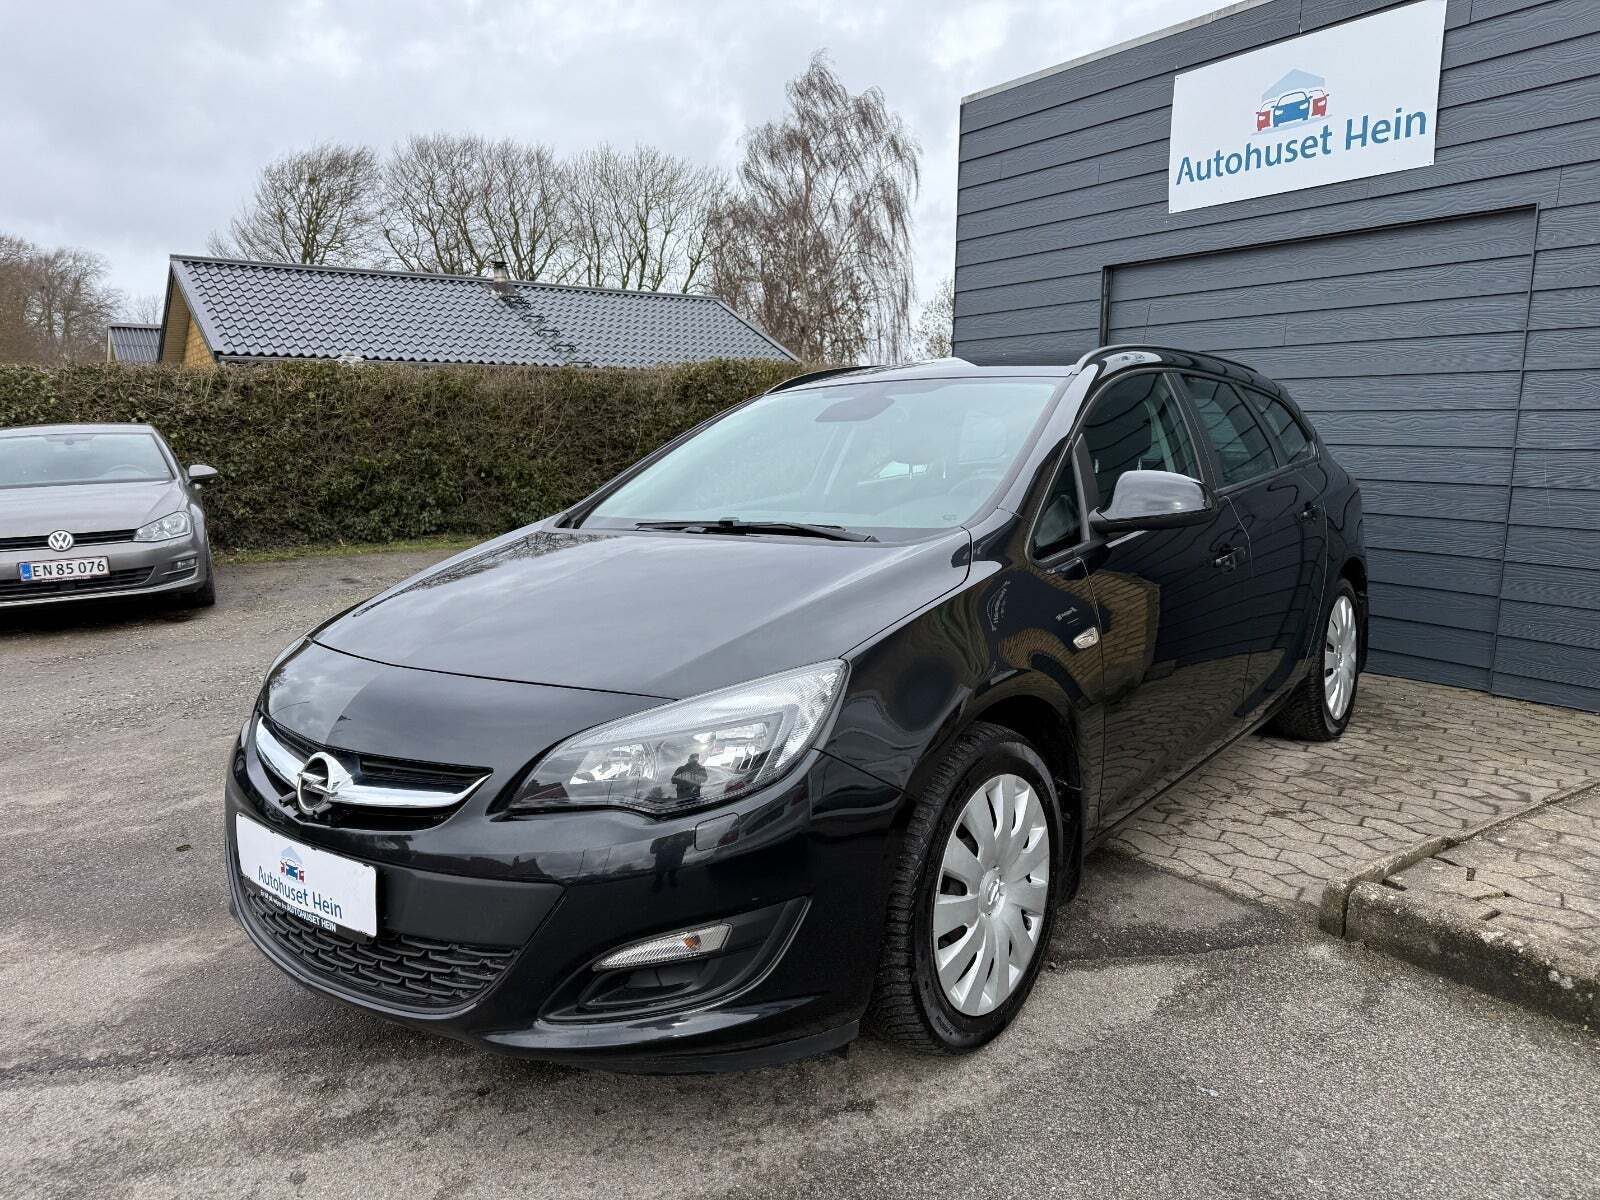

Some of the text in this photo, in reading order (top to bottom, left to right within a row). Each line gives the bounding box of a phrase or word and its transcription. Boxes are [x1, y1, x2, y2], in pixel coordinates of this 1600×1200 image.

[1176, 108, 1427, 186] Autohuset Hein
[32, 560, 105, 577] EN 85 076
[258, 865, 309, 907] Autohuset
[312, 891, 343, 919] Hein
[321, 918, 337, 933] HEIN
